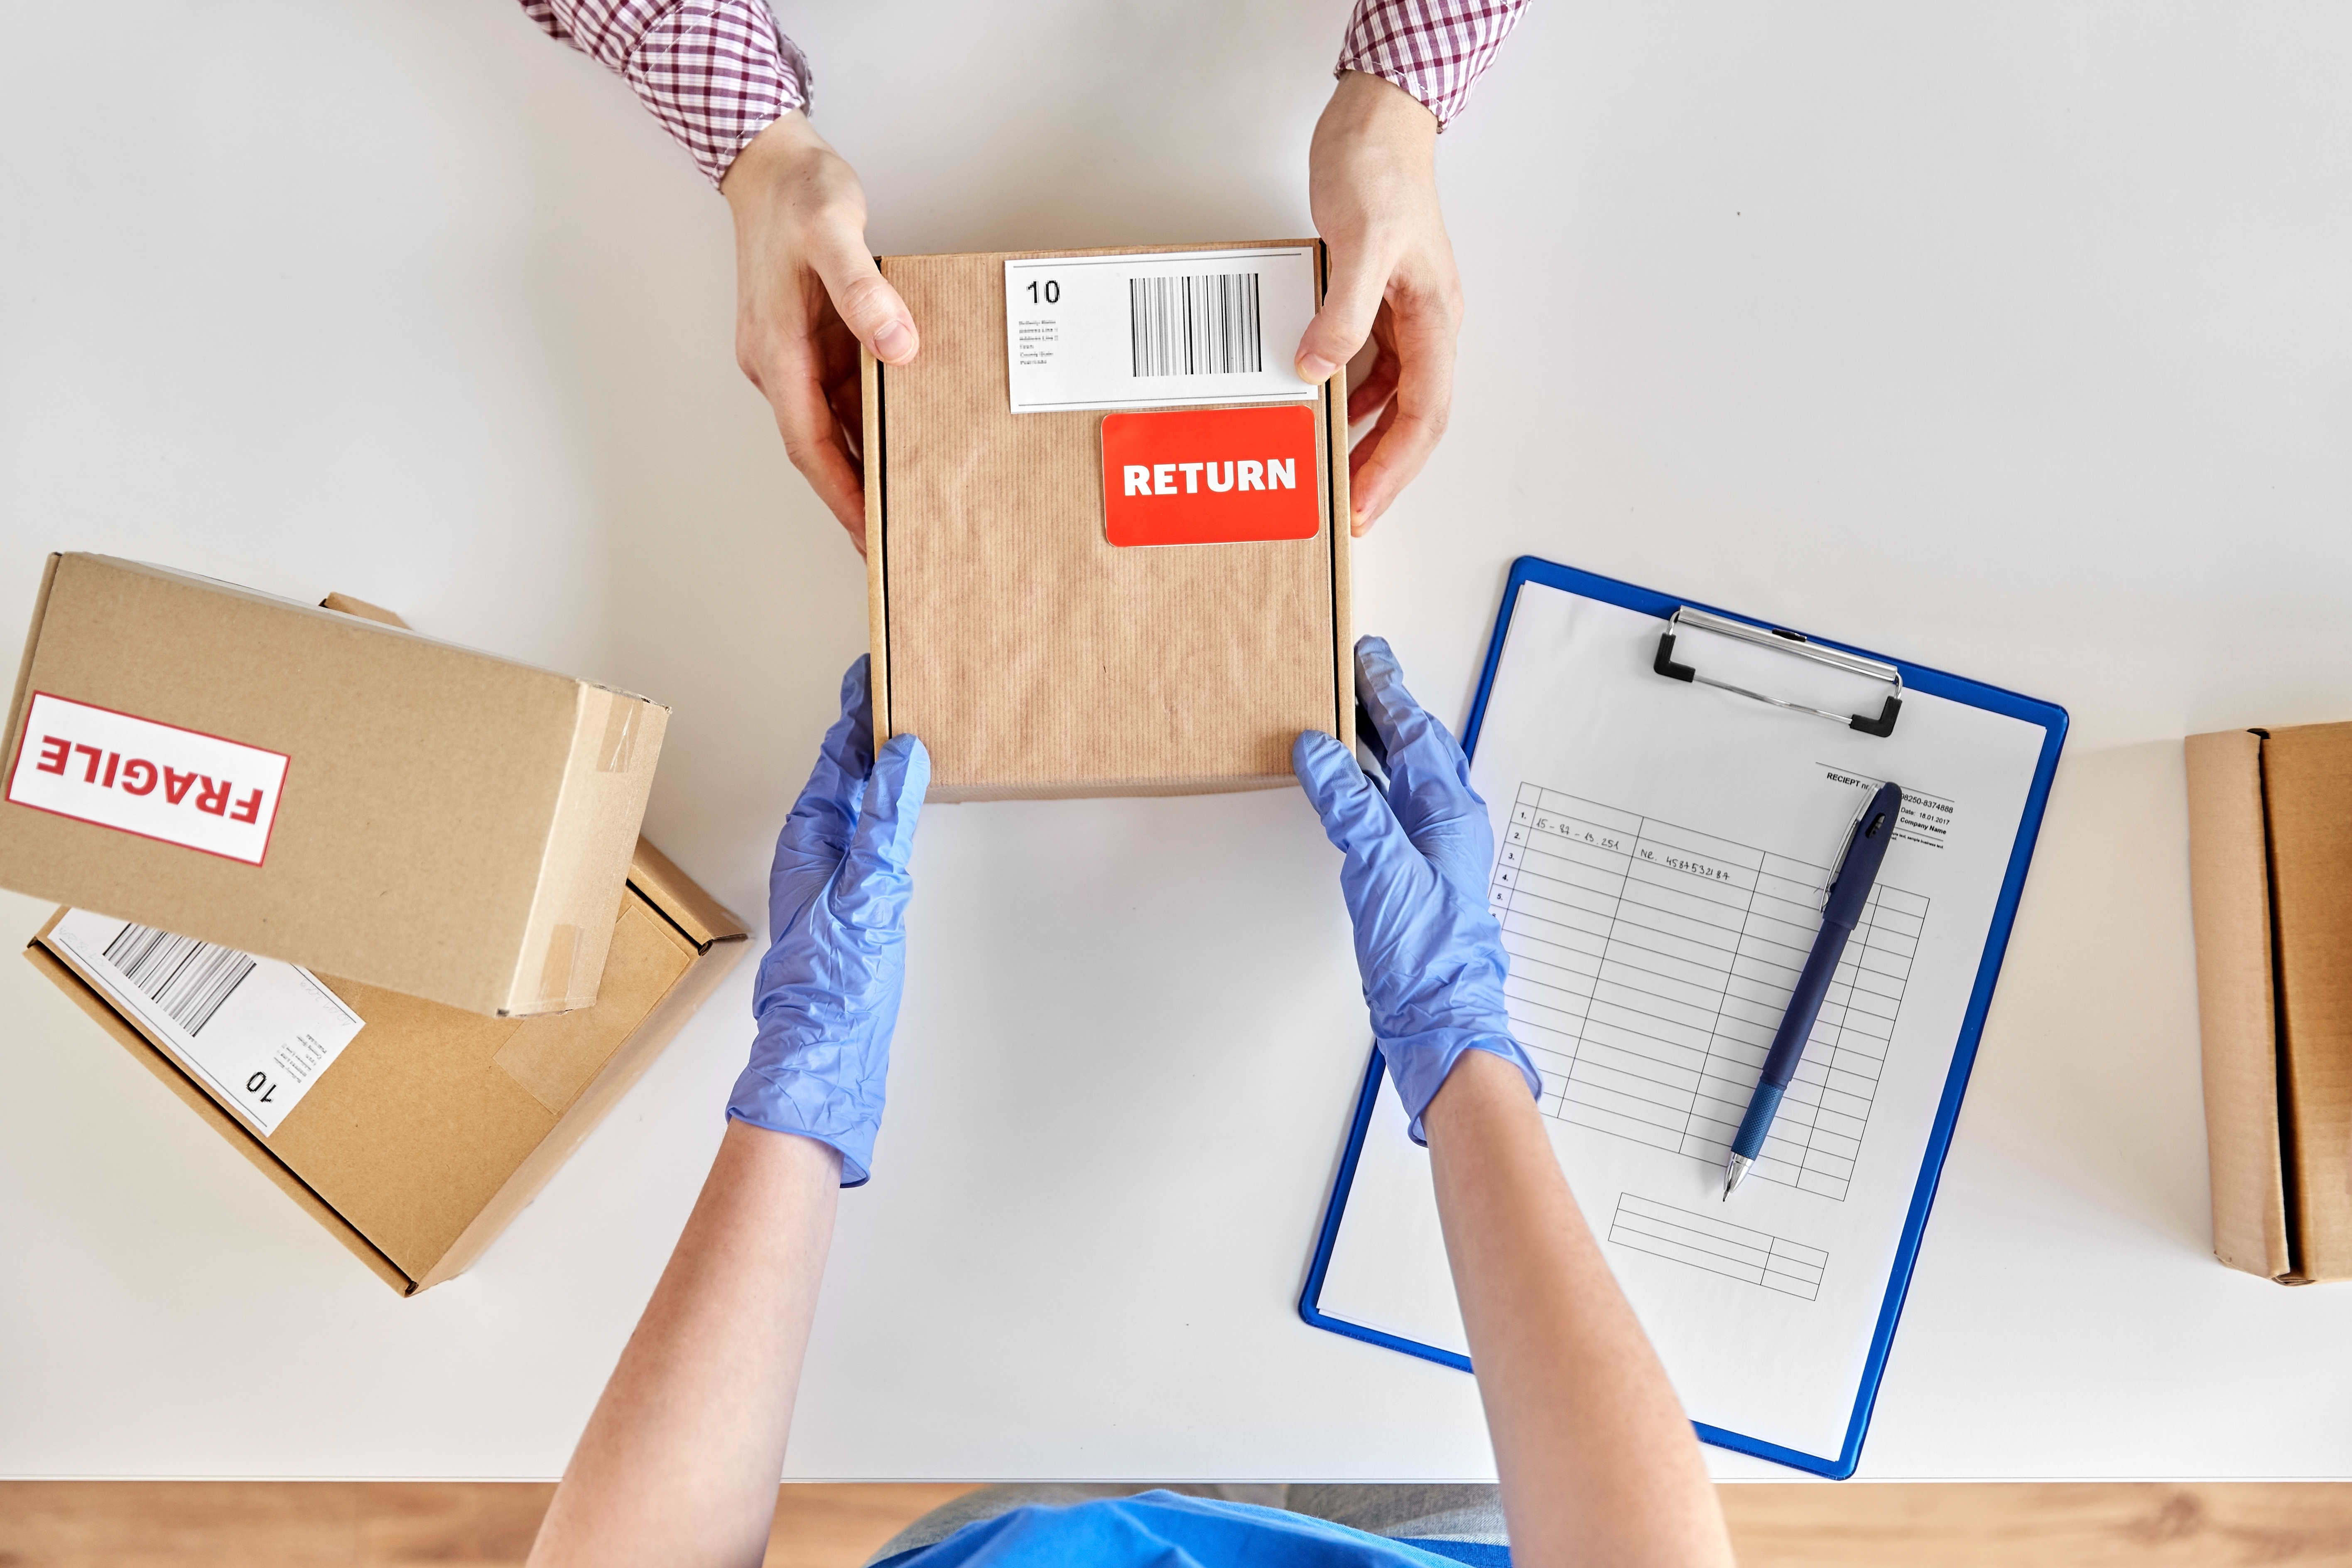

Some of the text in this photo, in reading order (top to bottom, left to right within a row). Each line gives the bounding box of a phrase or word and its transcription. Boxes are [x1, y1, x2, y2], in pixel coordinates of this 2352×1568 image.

[1027, 280, 1060, 304] 10
[1123, 458, 1296, 496] RETURN
[36, 734, 264, 825] FRAGILE
[1827, 772, 1860, 787] RECIEPT
[1900, 817, 1947, 835] Company Name
[1901, 807, 1950, 826] Date: 18.01.2017
[246, 1071, 277, 1102] 10
